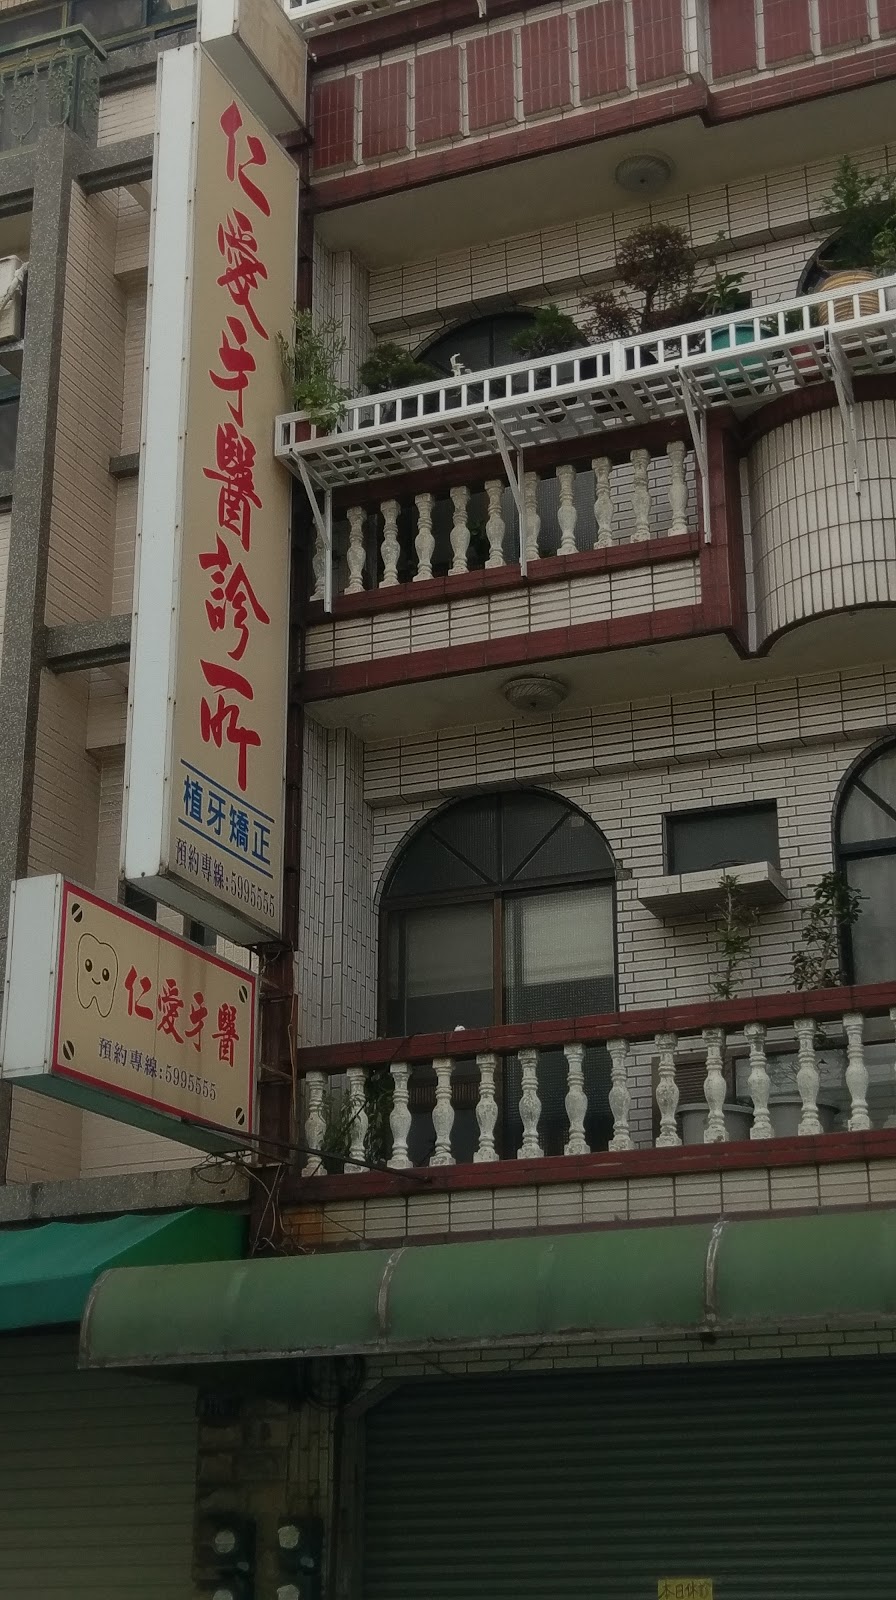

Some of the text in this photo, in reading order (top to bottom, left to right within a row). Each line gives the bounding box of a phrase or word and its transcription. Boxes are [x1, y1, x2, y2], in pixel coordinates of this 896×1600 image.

[198, 99, 271, 792] 仁愛牙醫診所
[182, 774, 271, 866] 植牙矯正
[124, 964, 240, 1068] 仁愛牙醫
